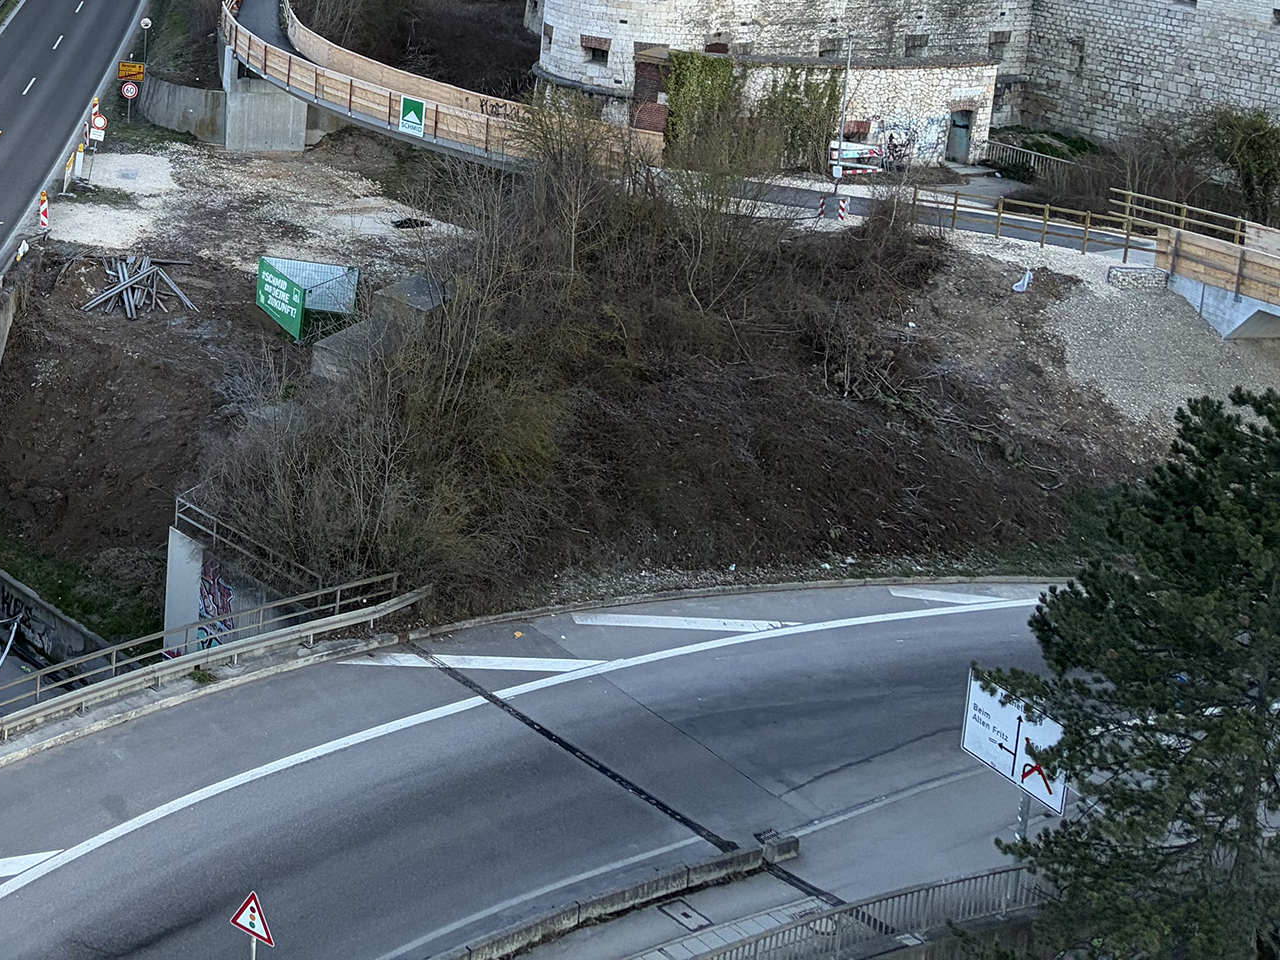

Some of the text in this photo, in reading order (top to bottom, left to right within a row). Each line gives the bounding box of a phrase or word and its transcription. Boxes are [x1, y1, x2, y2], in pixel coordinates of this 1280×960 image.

[401, 122, 422, 133] SCHMID
[267, 294, 297, 318] ZUKUNFT!
[972, 702, 991, 720] Beim
[972, 713, 1009, 742] Alten Fritz
